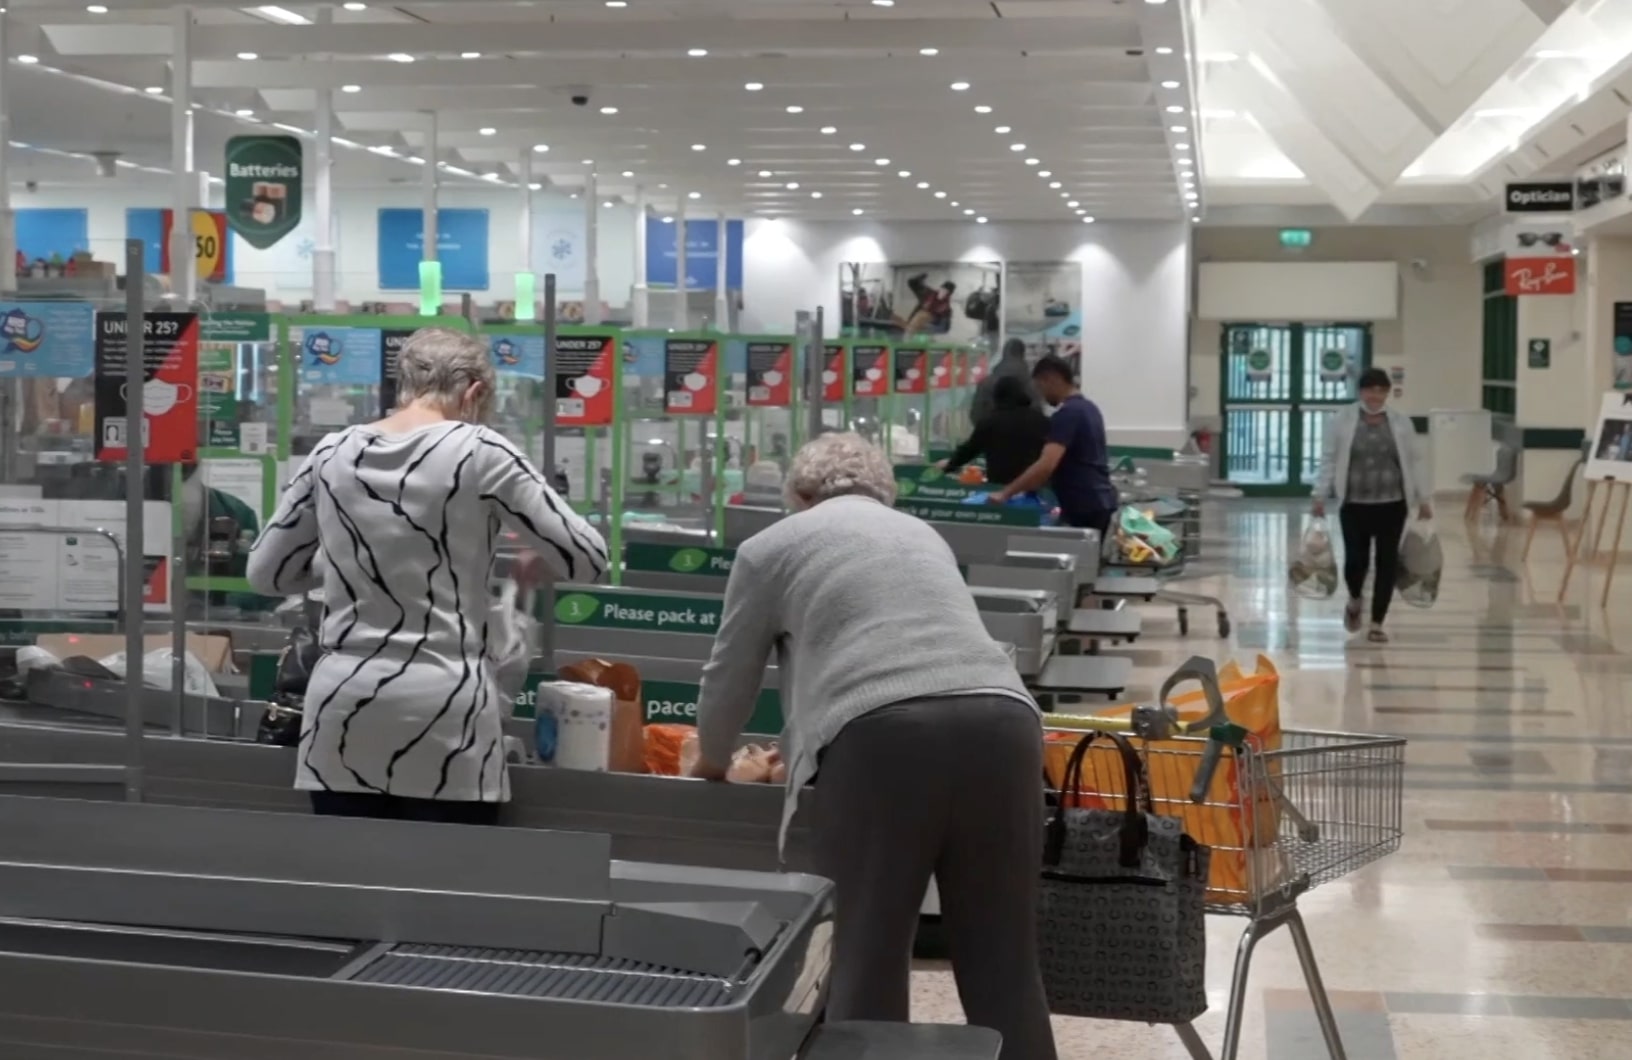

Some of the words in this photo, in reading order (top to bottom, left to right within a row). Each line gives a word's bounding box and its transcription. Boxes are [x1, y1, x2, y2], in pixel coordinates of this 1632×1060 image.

[229, 162, 298, 177] Batteries
[1510, 190, 1570, 205] Optician
[103, 320, 153, 334] UNR
[155, 320, 179, 335] 25?
[604, 603, 654, 621] Please
[657, 608, 697, 626] pack
[699, 611, 716, 625] at
[515, 690, 535, 706] at
[647, 698, 697, 720] pace
